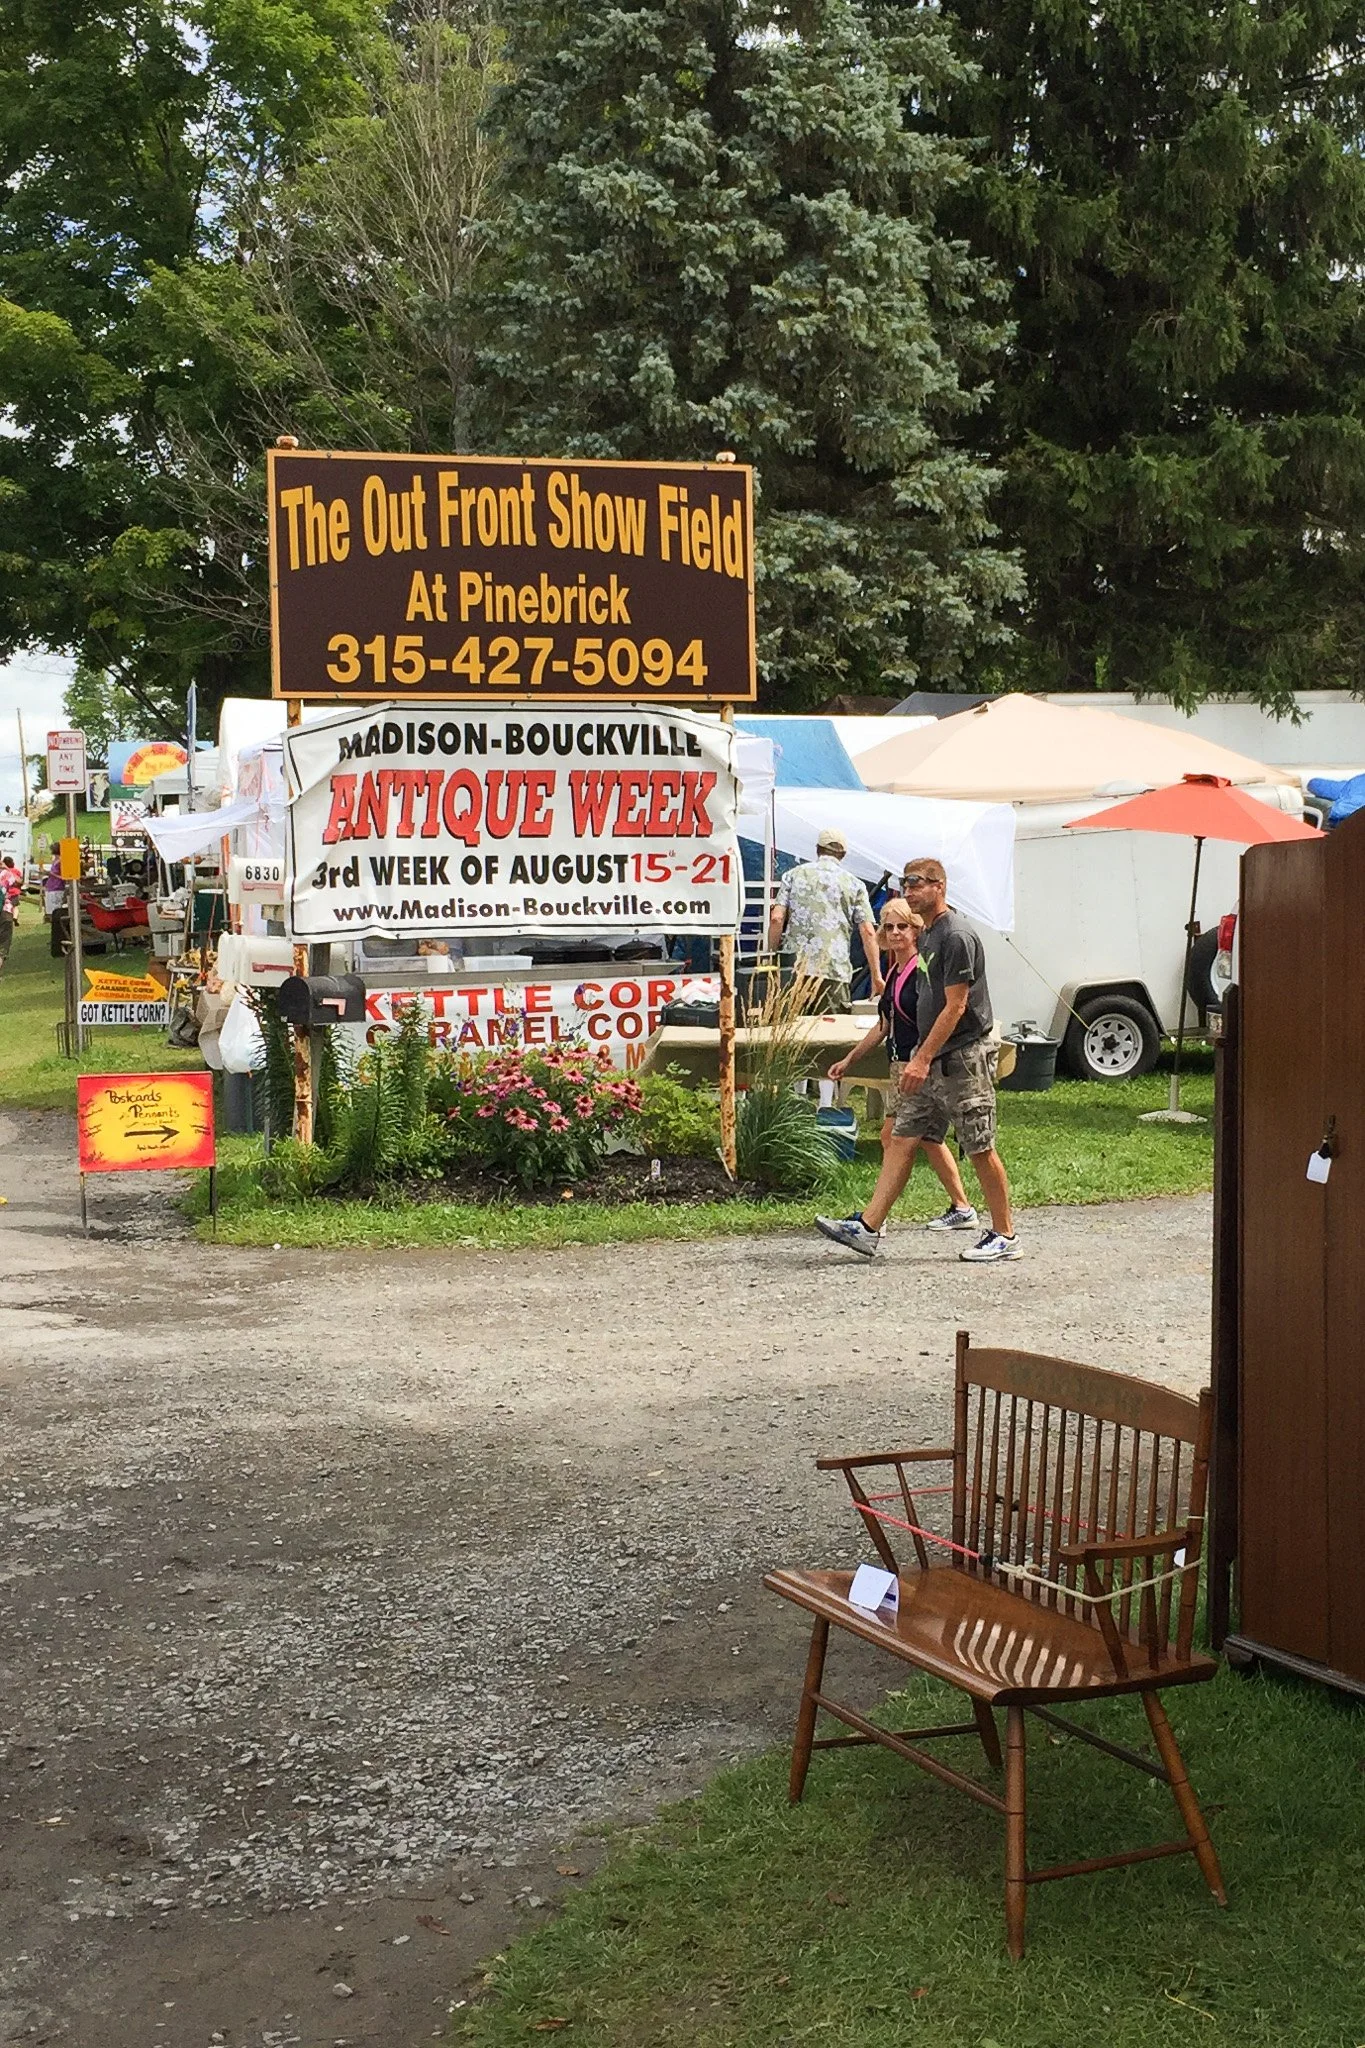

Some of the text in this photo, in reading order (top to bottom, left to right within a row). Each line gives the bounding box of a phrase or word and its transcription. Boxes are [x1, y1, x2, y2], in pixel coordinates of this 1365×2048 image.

[281, 470, 745, 579] The Out Front Show Field
[406, 570, 631, 624] At Pinebrick
[326, 633, 708, 686] 315-427-5094
[59, 753, 73, 761] ANY
[338, 722, 702, 765] MADISON-BOUCKVILLE
[322, 768, 717, 848] ANTIQUE WEEK
[245, 866, 280, 882] 6830
[311, 855, 360, 890] 3rd
[369, 855, 451, 886] WEEK
[460, 855, 499, 886] OF
[509, 854, 629, 885] AUGUST
[333, 897, 710, 922] www.Madison-Bouckville.com
[81, 1004, 166, 1022] GOT KETTLE CORN?
[365, 978, 711, 1022] KETTLE COR
[366, 1011, 663, 1048] CRAMEL CO
[105, 1089, 161, 1104] Postcards
